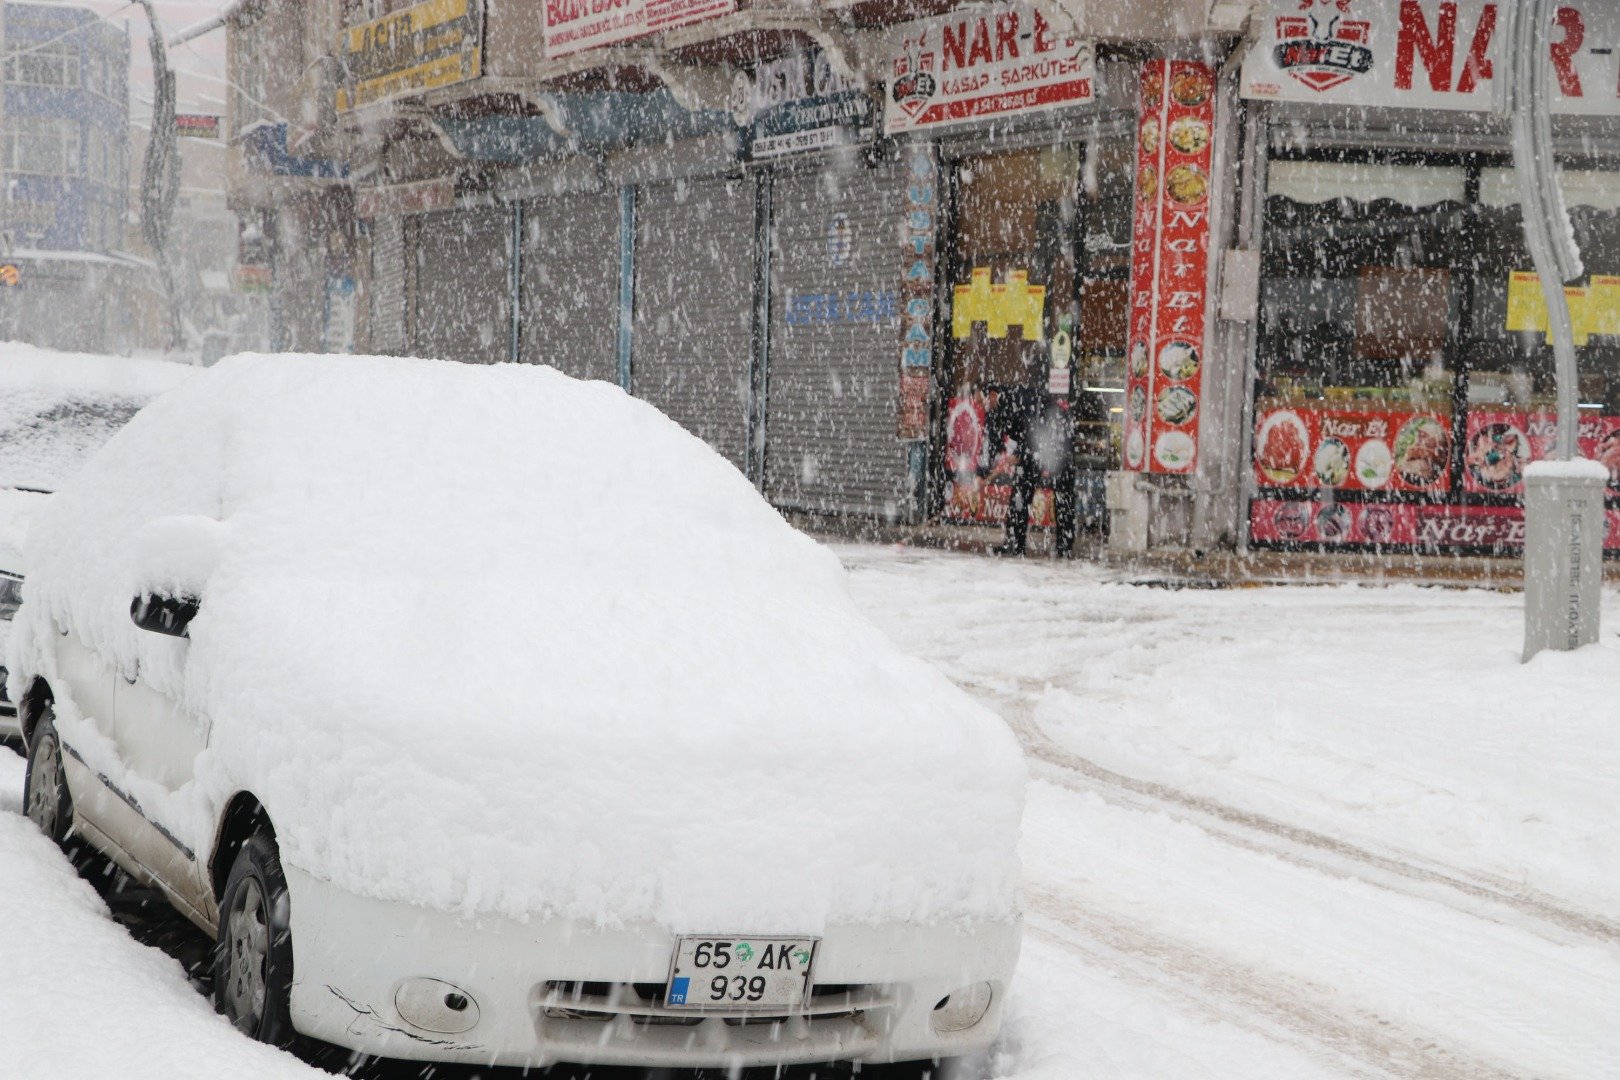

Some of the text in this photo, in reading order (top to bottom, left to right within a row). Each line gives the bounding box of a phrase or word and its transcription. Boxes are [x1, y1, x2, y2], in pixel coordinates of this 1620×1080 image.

[942, 8, 1075, 71] NAR-E
[941, 73, 990, 96] KASAP
[908, 184, 932, 280] USTA
[1165, 211, 1204, 333] Nar Et
[904, 299, 931, 367] CAM
[1320, 418, 1388, 438] Nar Et
[1420, 518, 1490, 543] Nar
[694, 941, 796, 970] 65 AK
[671, 994, 684, 1003] TR
[710, 975, 766, 1001] 939
